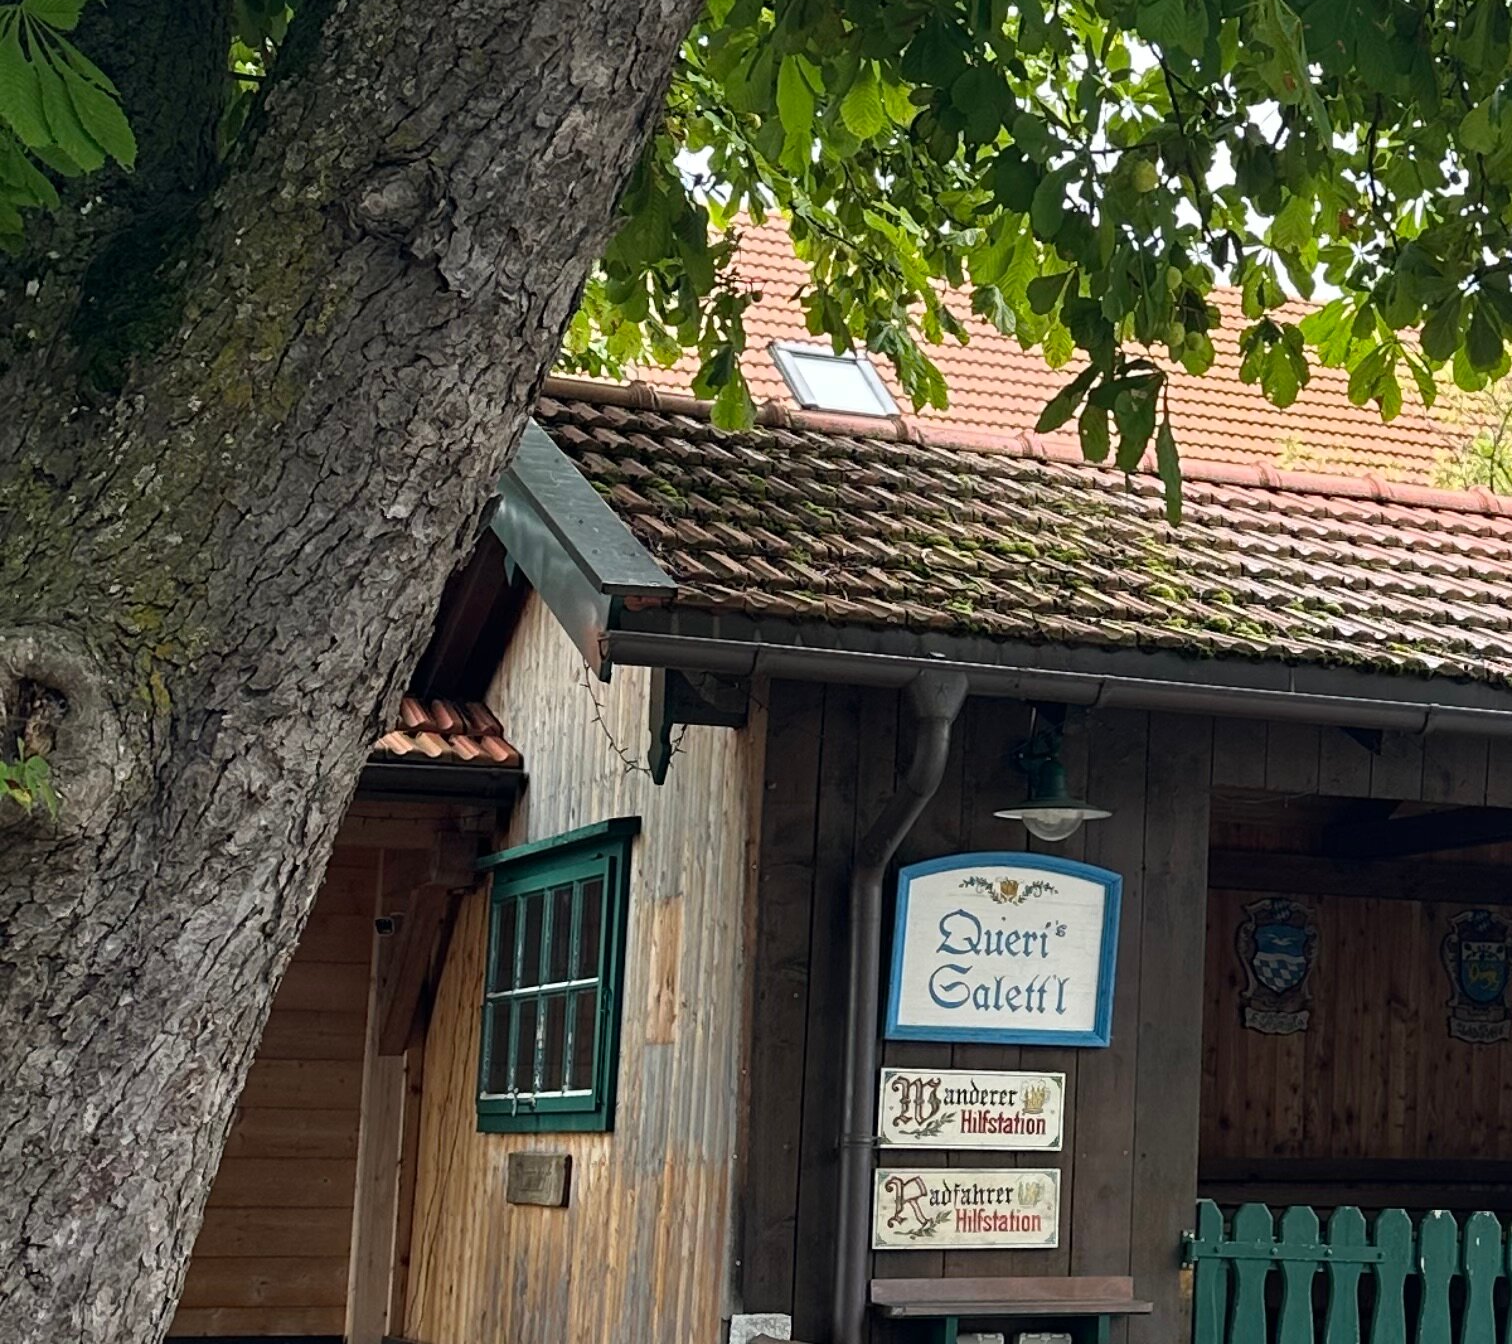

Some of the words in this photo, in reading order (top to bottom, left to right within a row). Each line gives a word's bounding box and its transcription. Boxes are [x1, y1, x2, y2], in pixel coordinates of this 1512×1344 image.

[935, 908, 1067, 958] Queri's
[892, 1076, 1017, 1127] Wanderer
[960, 1110, 1046, 1136] Hilfstation
[886, 1175, 1013, 1228] Radfahrer
[955, 1208, 1042, 1233] Hilfstation
